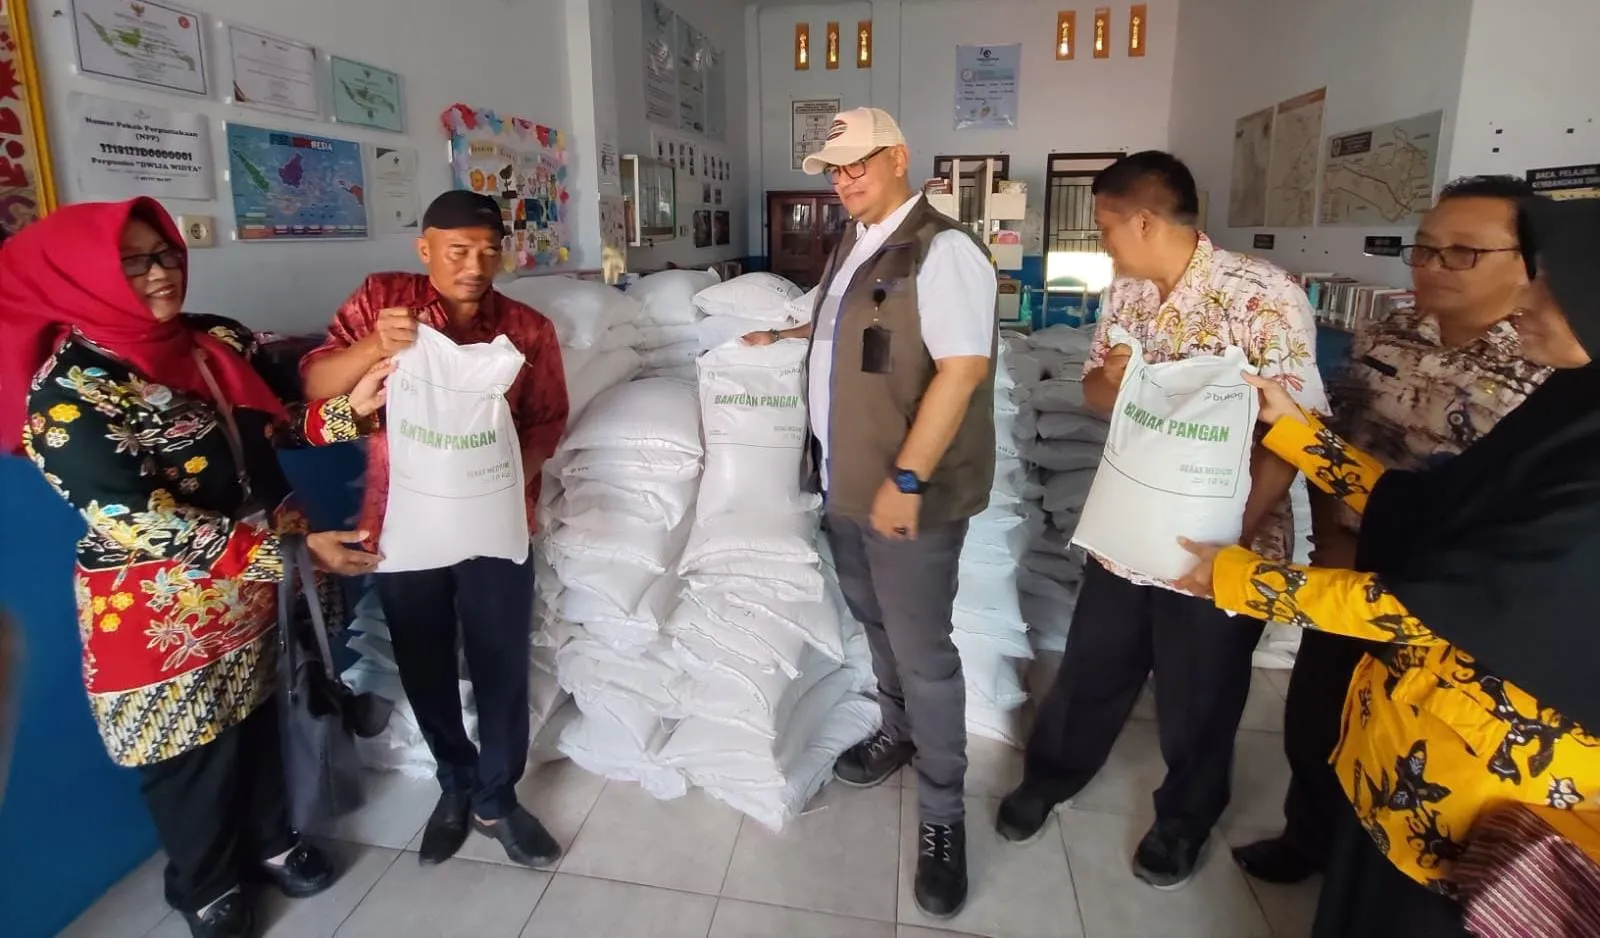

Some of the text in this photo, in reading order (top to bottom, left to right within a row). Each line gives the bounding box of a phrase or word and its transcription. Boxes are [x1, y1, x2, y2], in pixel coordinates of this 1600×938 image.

[714, 392, 799, 409] BANTUAN PANGAN
[444, 429, 497, 450] PANGAN
[1167, 418, 1230, 443] PANGAN
